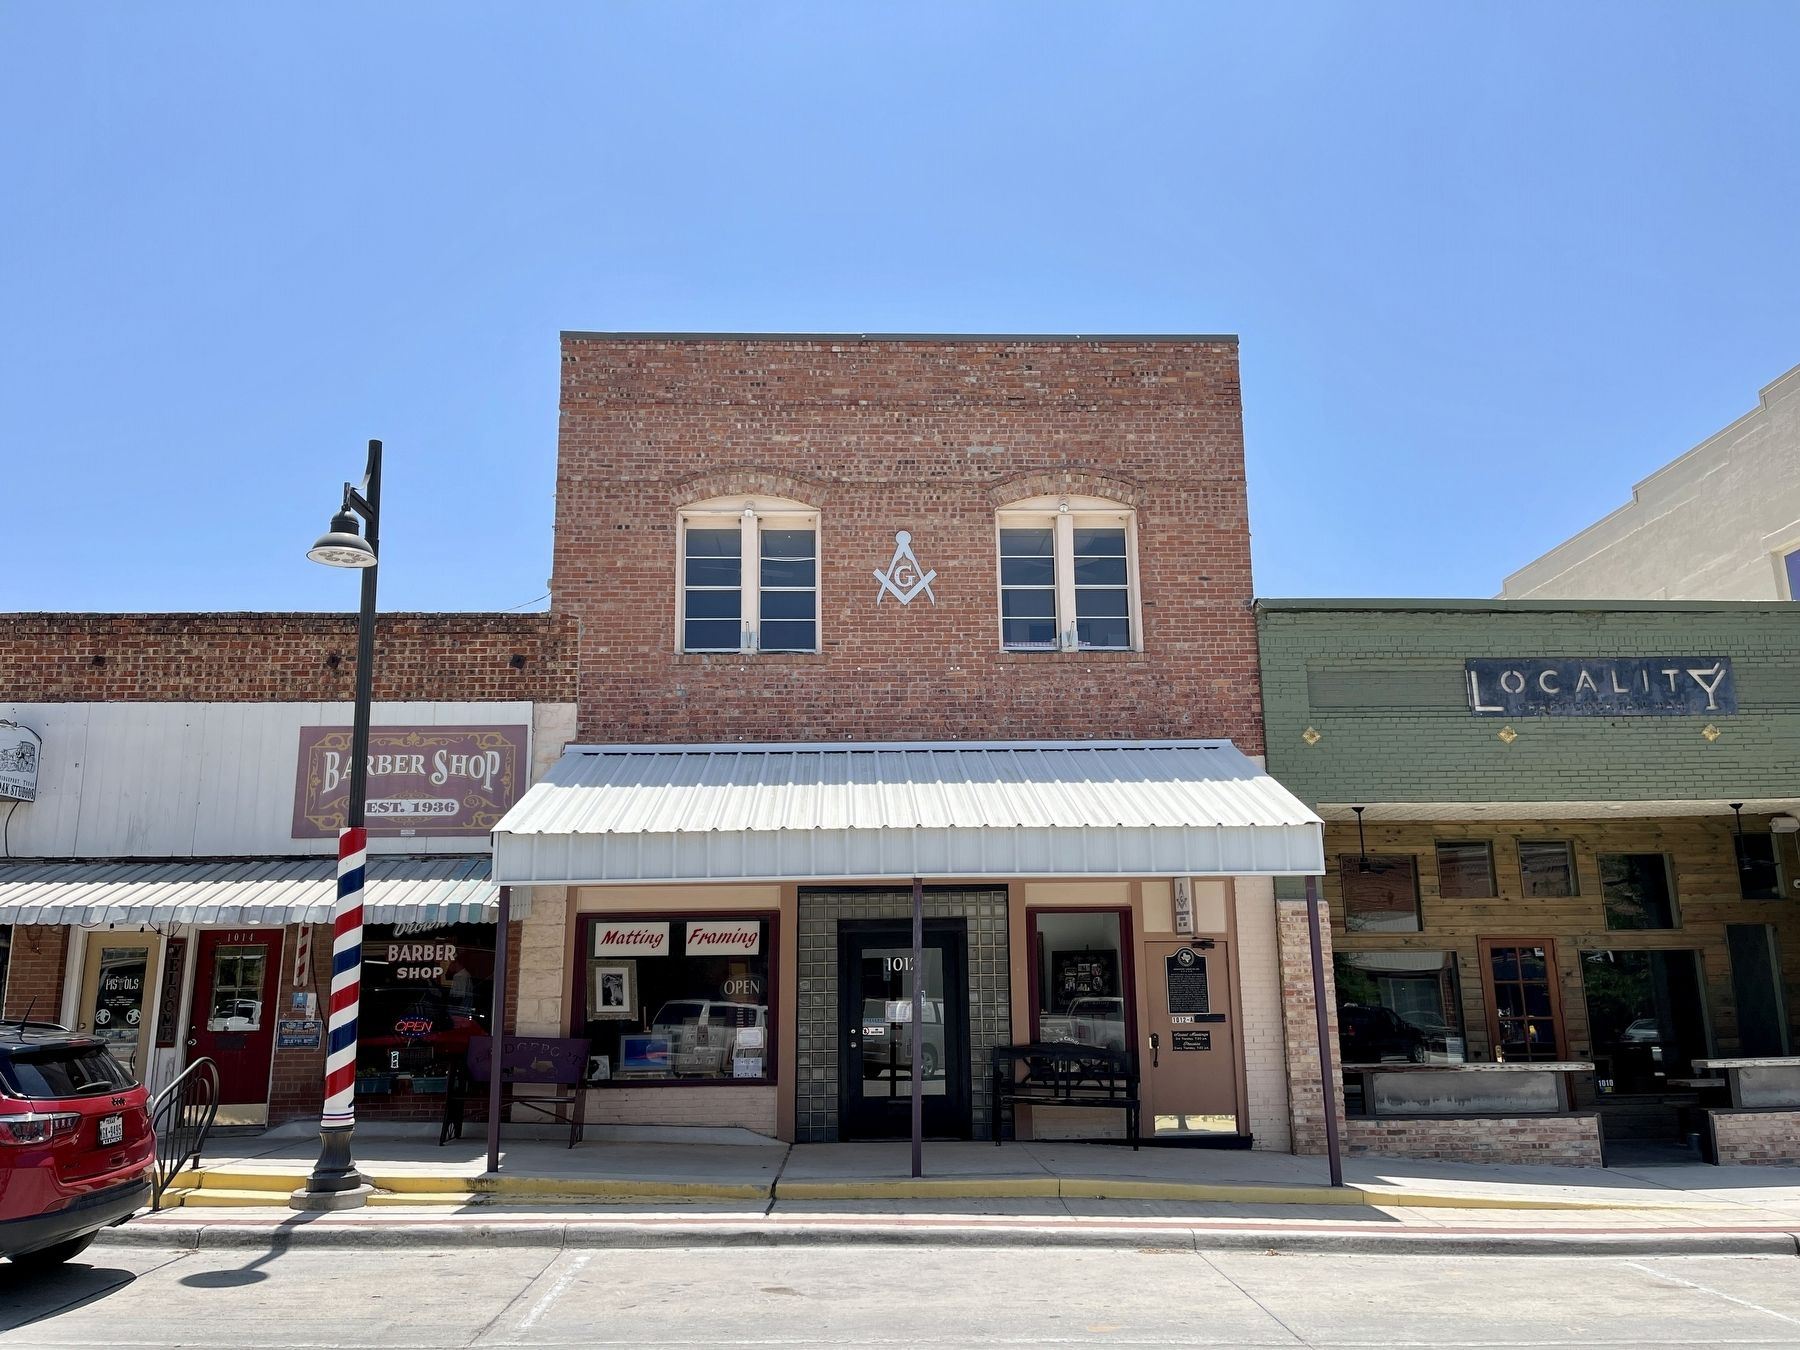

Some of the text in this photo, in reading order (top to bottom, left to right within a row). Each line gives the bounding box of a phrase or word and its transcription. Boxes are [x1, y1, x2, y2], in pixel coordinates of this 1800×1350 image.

[894, 565, 916, 587] G
[1469, 662, 1727, 712] LOCALITY
[430, 749, 500, 791] SHOP
[365, 801, 455, 813] EST. 1936
[227, 932, 254, 942] 1014
[600, 929, 664, 949] Matting
[687, 928, 758, 949] Framing
[388, 944, 457, 962] BARBER
[396, 967, 444, 979] SHOP
[723, 980, 760, 995] OPEN
[394, 1021, 433, 1033] OPEN
